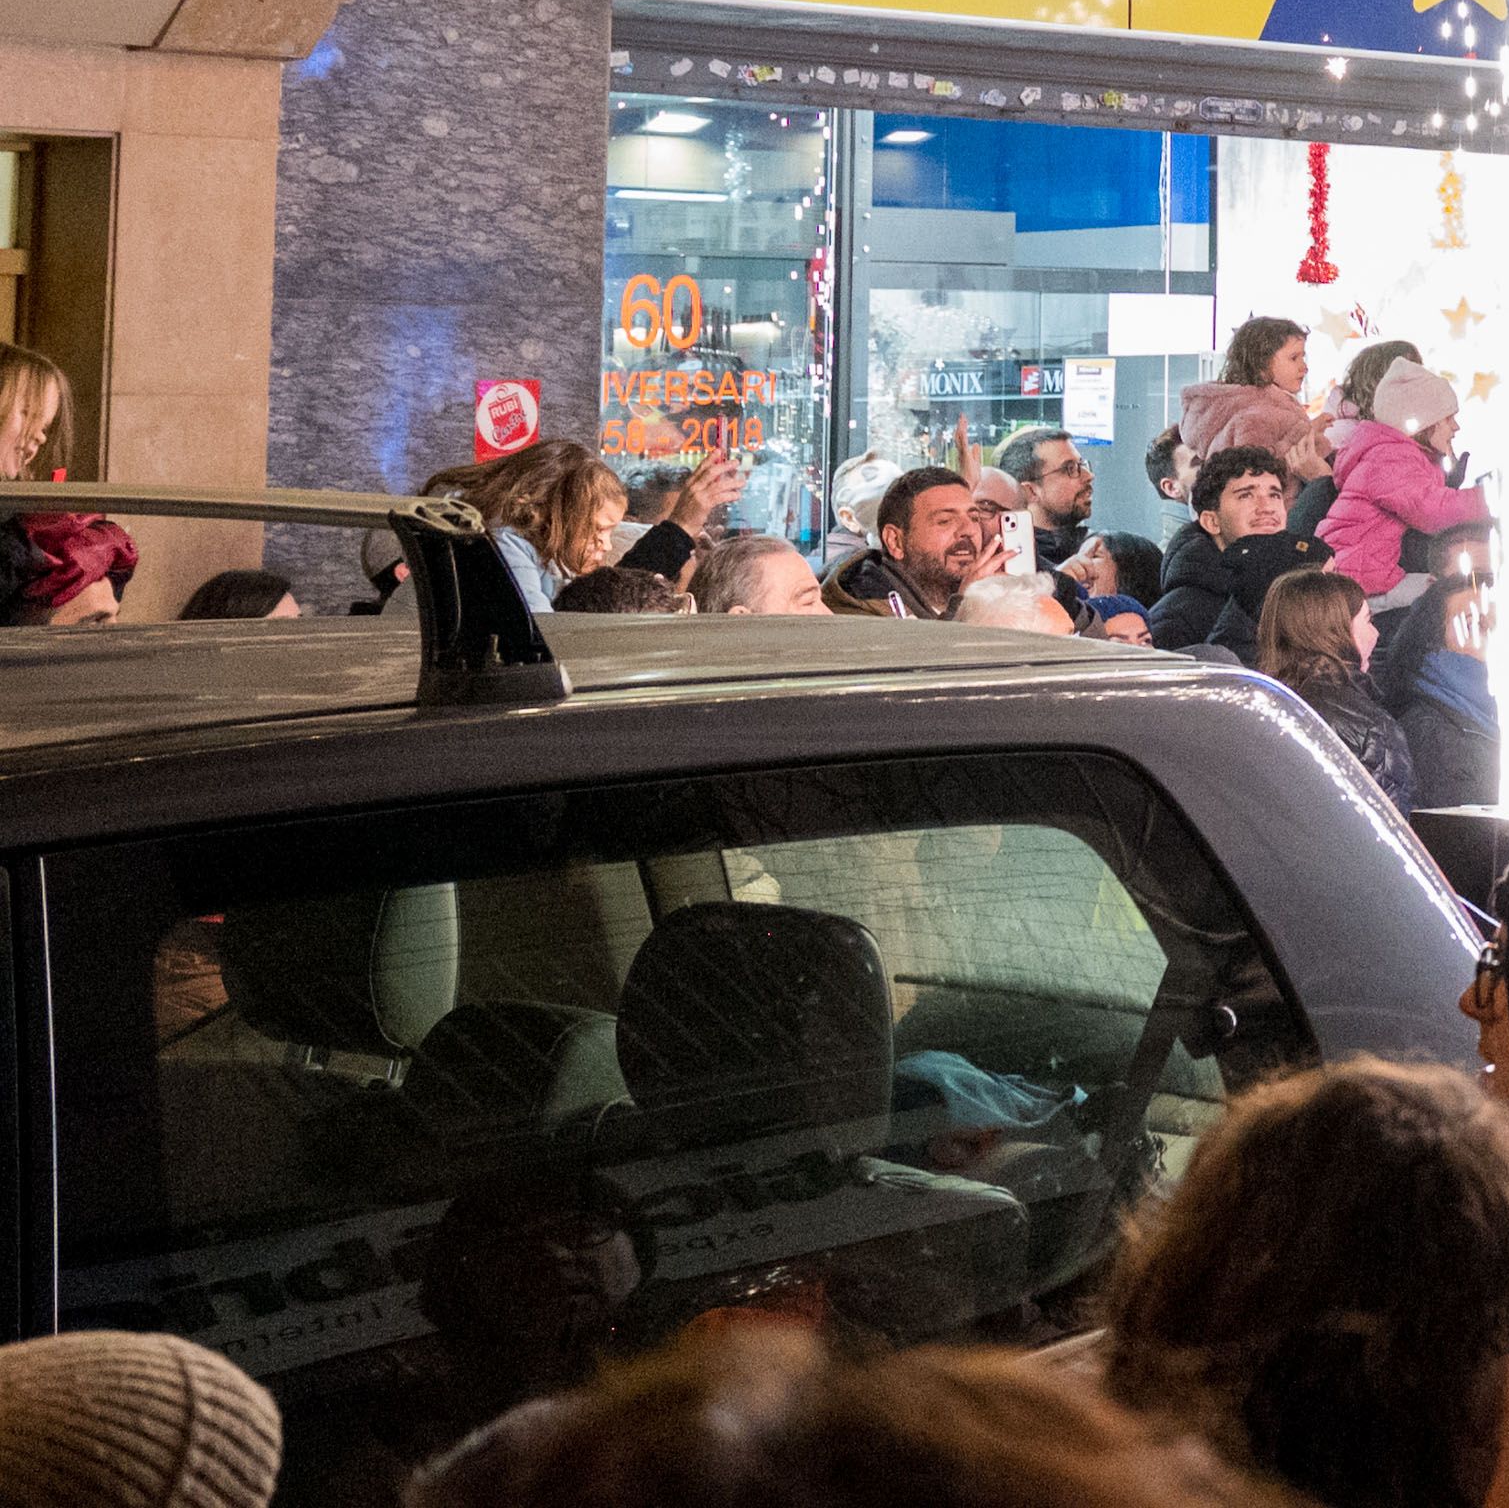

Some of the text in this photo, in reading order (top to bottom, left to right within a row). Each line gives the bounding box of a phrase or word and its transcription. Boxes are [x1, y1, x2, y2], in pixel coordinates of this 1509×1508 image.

[621, 273, 703, 349] 60
[603, 369, 777, 407] IVERSARI
[919, 370, 984, 395] MONIX
[603, 418, 646, 455] 58
[682, 417, 765, 452] 2018
